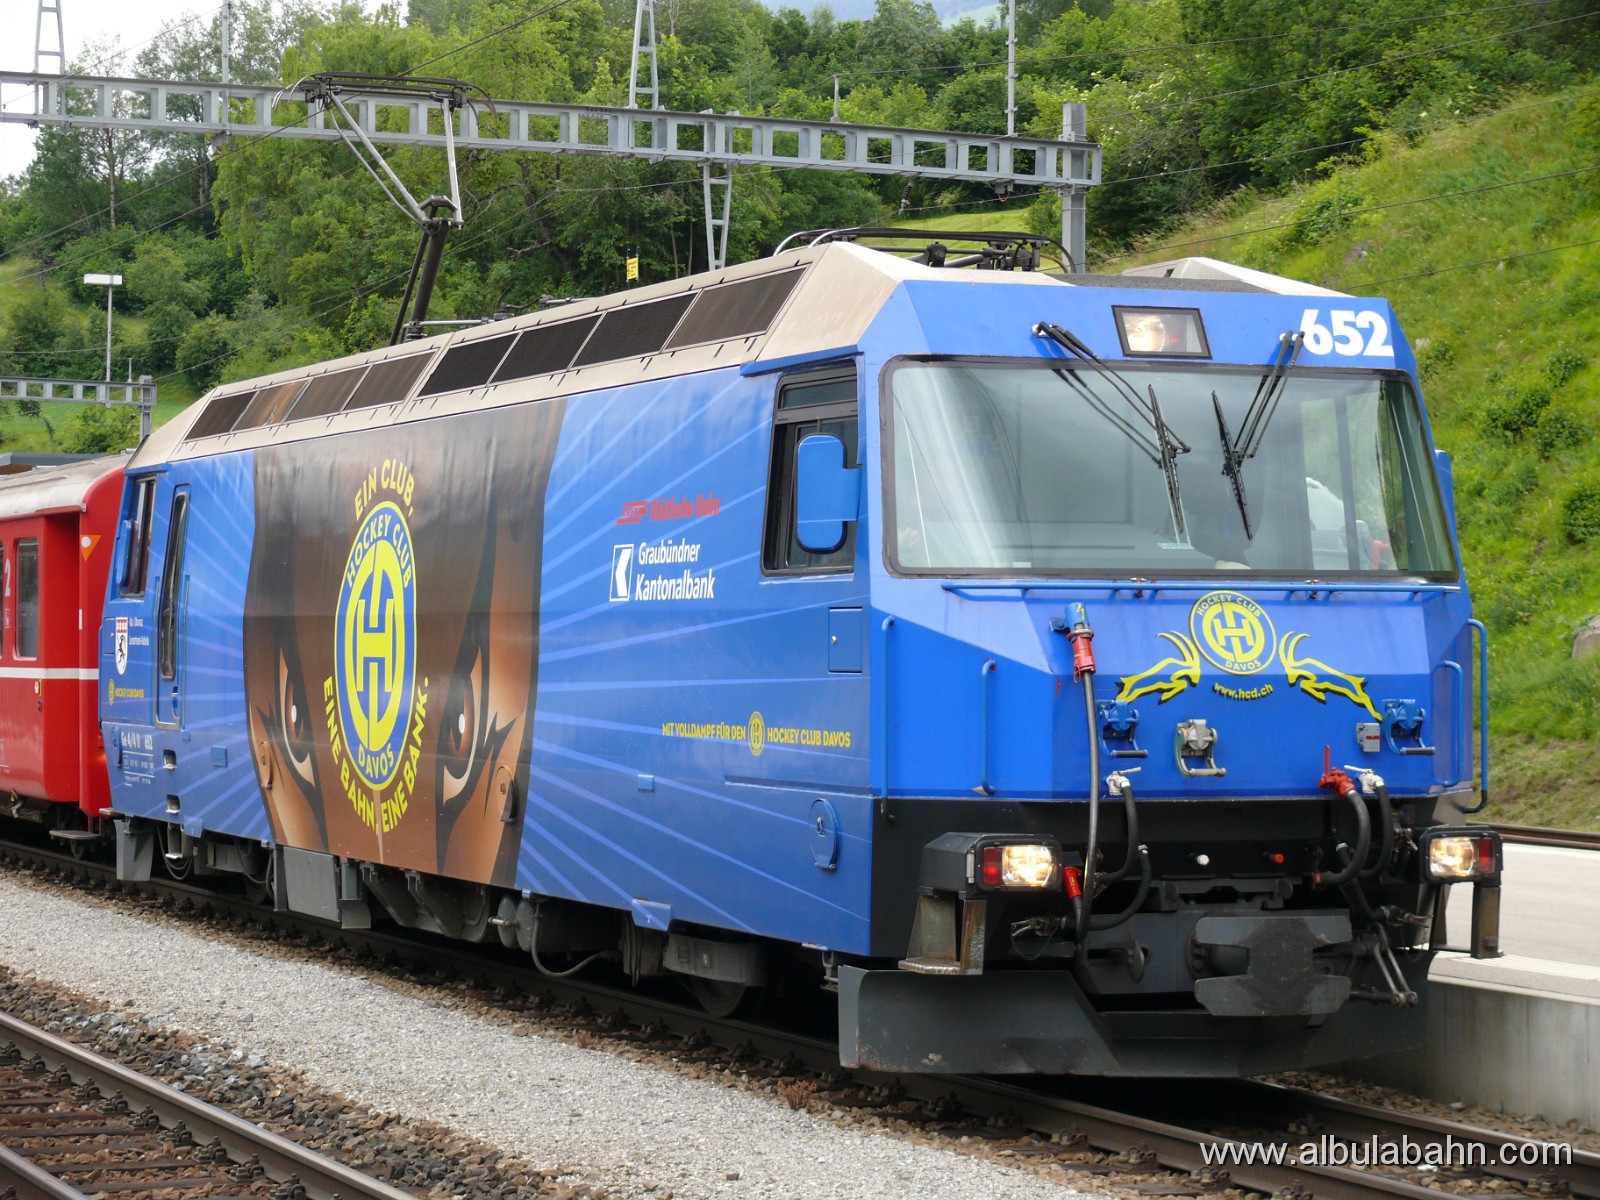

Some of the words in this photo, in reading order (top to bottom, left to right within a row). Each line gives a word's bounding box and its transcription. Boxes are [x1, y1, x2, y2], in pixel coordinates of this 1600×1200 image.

[1300, 309, 1395, 357] 652
[354, 466, 377, 521] EIN
[381, 459, 414, 517] CLUB,
[696, 491, 720, 517] Bahn
[347, 513, 392, 588] HOCKEY
[392, 523, 412, 589] CLUB
[638, 538, 701, 565] Graubündner
[4, 558, 11, 597] 2
[635, 568, 715, 601] Kantonalbank
[1196, 594, 1232, 616] HOCKEY
[1237, 597, 1262, 617] CLUB
[1225, 659, 1262, 671] DAVOS
[1213, 682, 1274, 700] www.hcd.ch
[662, 722, 675, 737] MIT
[675, 722, 715, 739] VOLLDAMPF
[716, 721, 730, 740] FÜR
[731, 725, 746, 741] DEN
[767, 727, 799, 745] HOCKEY
[800, 730, 822, 746] CLUB
[823, 731, 851, 748] DAVOS
[323, 675, 342, 766] EINE
[380, 780, 408, 833] EINE
[358, 743, 394, 779] DAVOS
